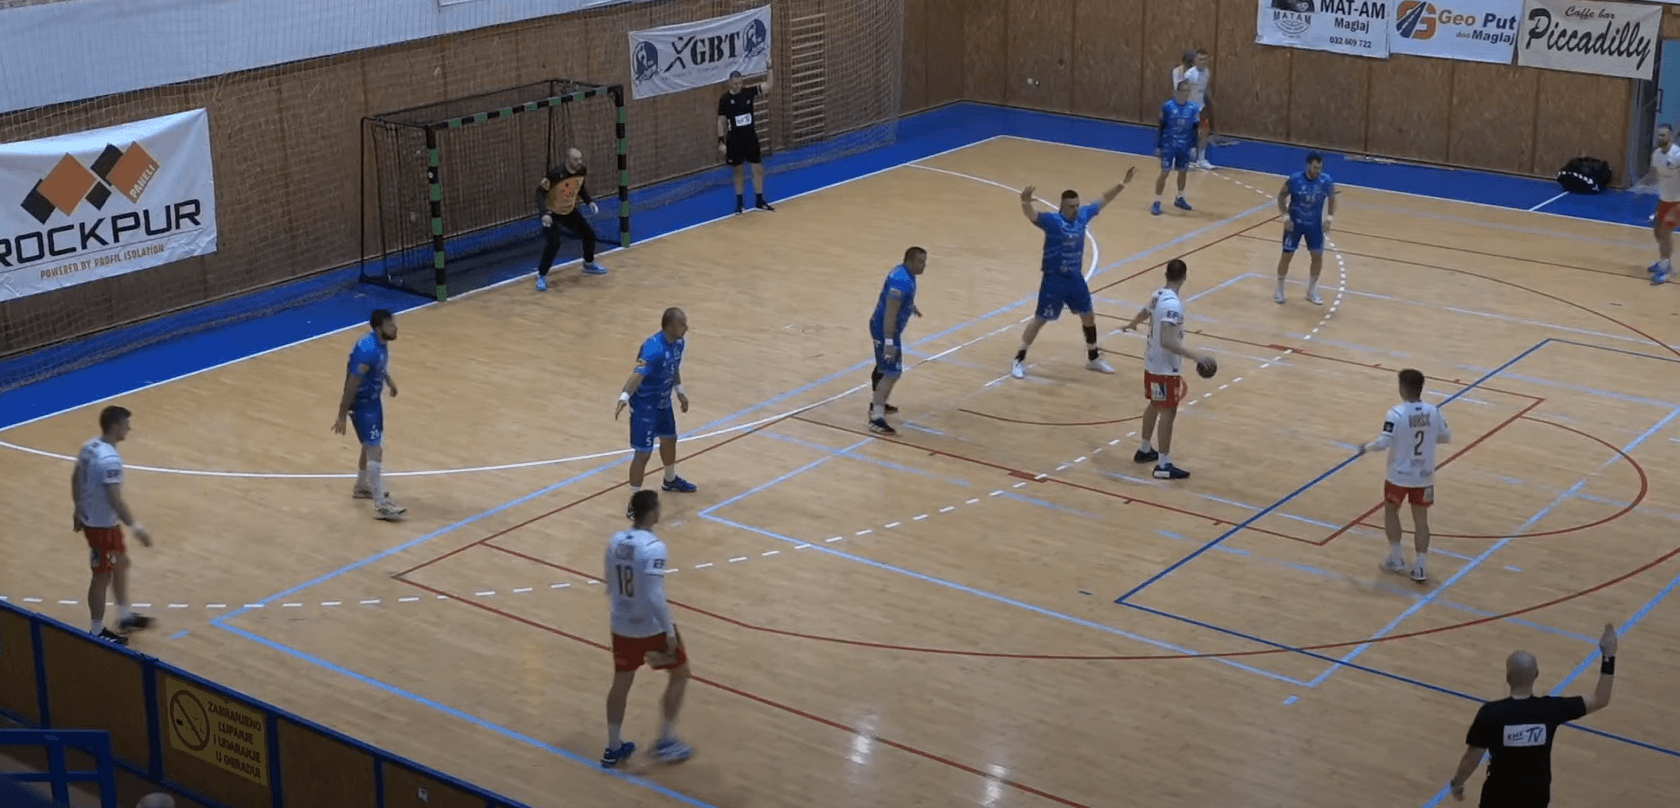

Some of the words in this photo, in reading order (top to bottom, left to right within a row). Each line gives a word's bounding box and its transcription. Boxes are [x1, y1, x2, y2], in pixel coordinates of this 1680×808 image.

[1273, 11, 1312, 25] MATAM
[1319, 0, 1386, 19] MAT-AM
[1565, 6, 1595, 19] Caffe
[1598, 8, 1616, 19] bar
[1334, 17, 1370, 34] Maglaj
[1438, 9, 1476, 26] Geo
[1482, 12, 1517, 30] Put
[1329, 36, 1343, 44] 032
[1359, 40, 1372, 48] 722
[1472, 30, 1516, 45] Maglaj
[1525, 8, 1651, 71] Piccadilly
[129, 165, 155, 198] PANELI
[40, 262, 79, 280] POWERED
[81, 259, 91, 269] BY
[94, 253, 121, 267] PROFIL
[124, 243, 165, 260] ISOLATION
[1413, 430, 1424, 456] 2
[615, 564, 635, 598] 18
[1525, 726, 1543, 743] TV
[216, 750, 222, 763] U
